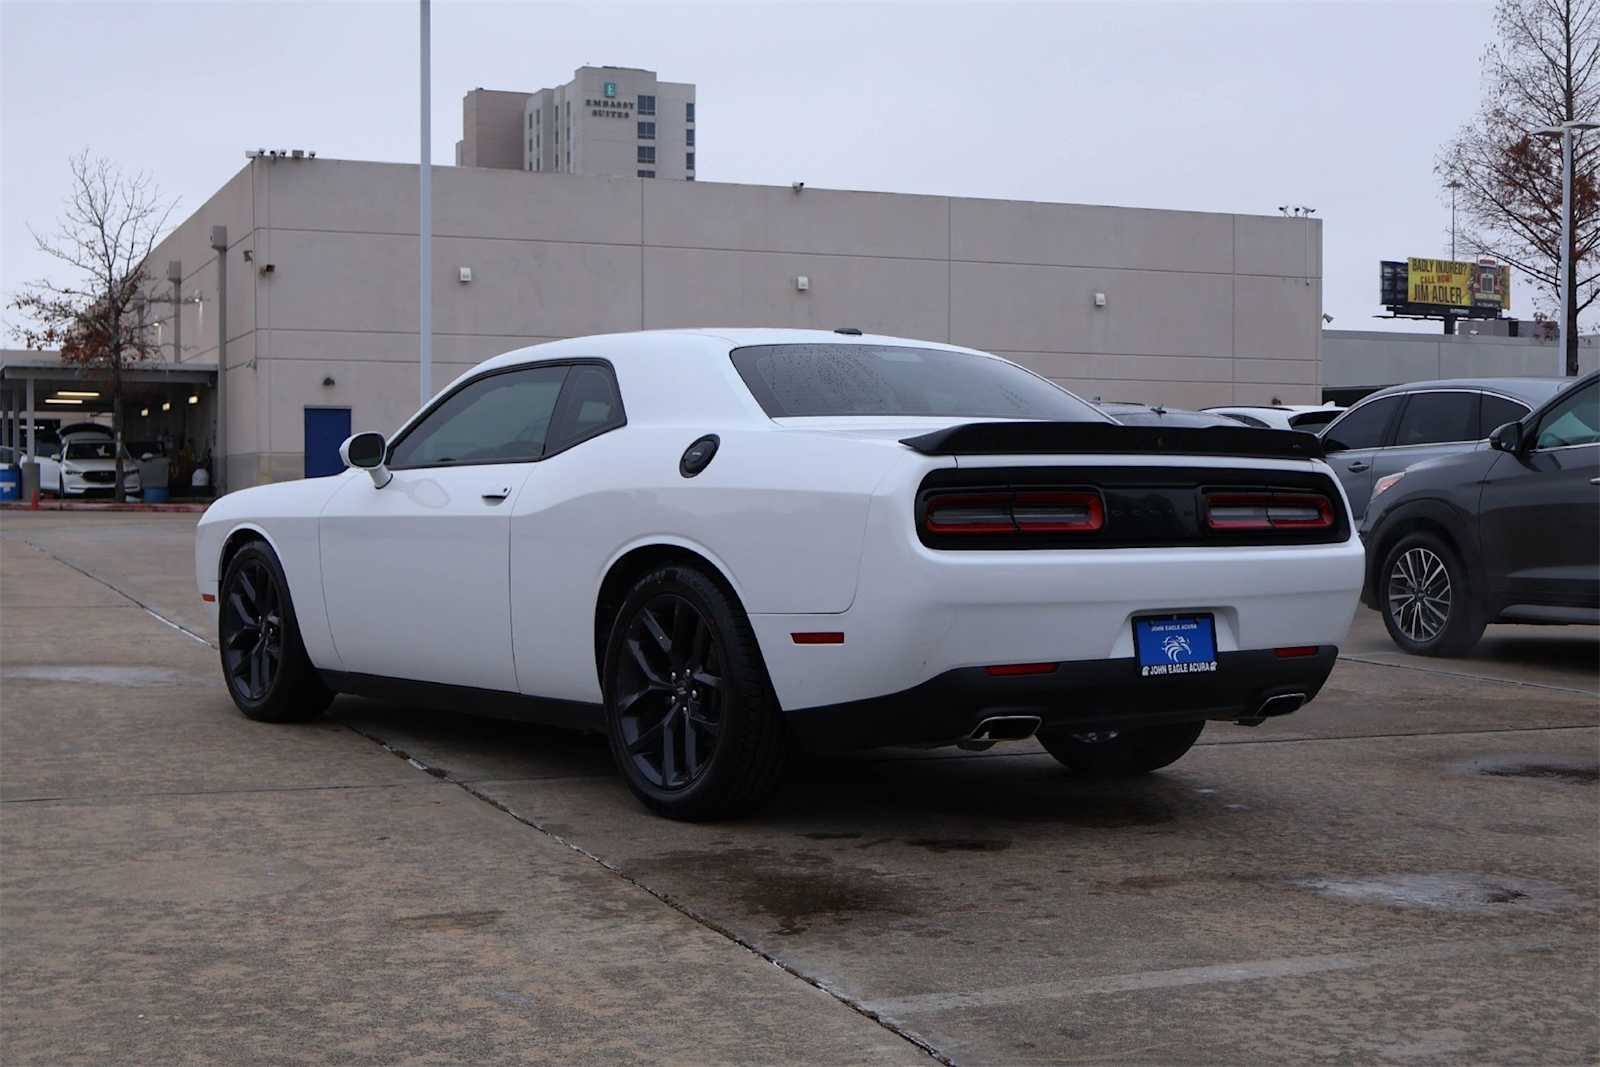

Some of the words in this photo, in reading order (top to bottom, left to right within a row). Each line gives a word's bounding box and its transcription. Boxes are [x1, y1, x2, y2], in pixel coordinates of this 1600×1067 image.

[585, 99, 634, 110] EMBASSY
[592, 109, 630, 119] SUITES
[1412, 258, 1434, 273] BADLY
[1414, 283, 1429, 301] JIM
[1432, 285, 1462, 304] ADLER
[1150, 664, 1167, 676] JOHN
[1168, 663, 1188, 674] EAGLE
[1189, 661, 1210, 673] ACURA
